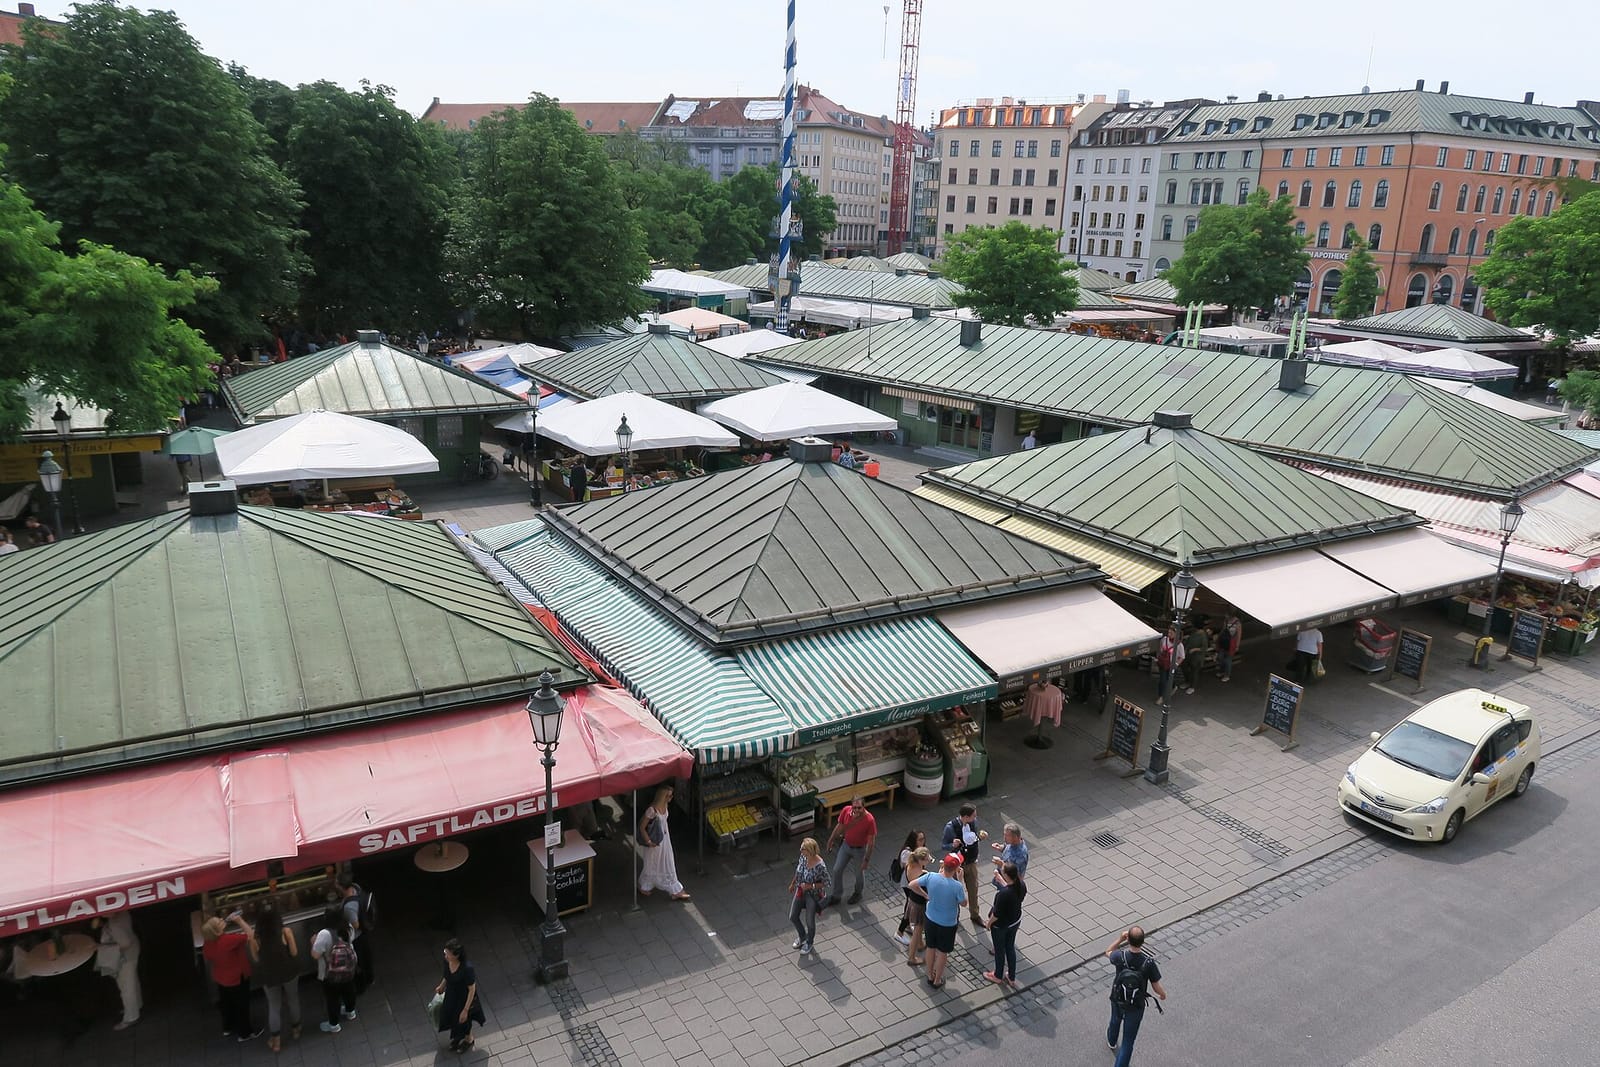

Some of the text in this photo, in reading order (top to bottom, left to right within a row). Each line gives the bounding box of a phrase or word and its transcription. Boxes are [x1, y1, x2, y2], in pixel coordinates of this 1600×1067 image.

[1313, 251, 1349, 260] APOTHEKE
[1069, 656, 1094, 669] LUPPER
[812, 689, 987, 738] Italienische Marinas Feinkost
[358, 791, 559, 854] SAFTLADEN
[0, 876, 186, 930] TLADEN
